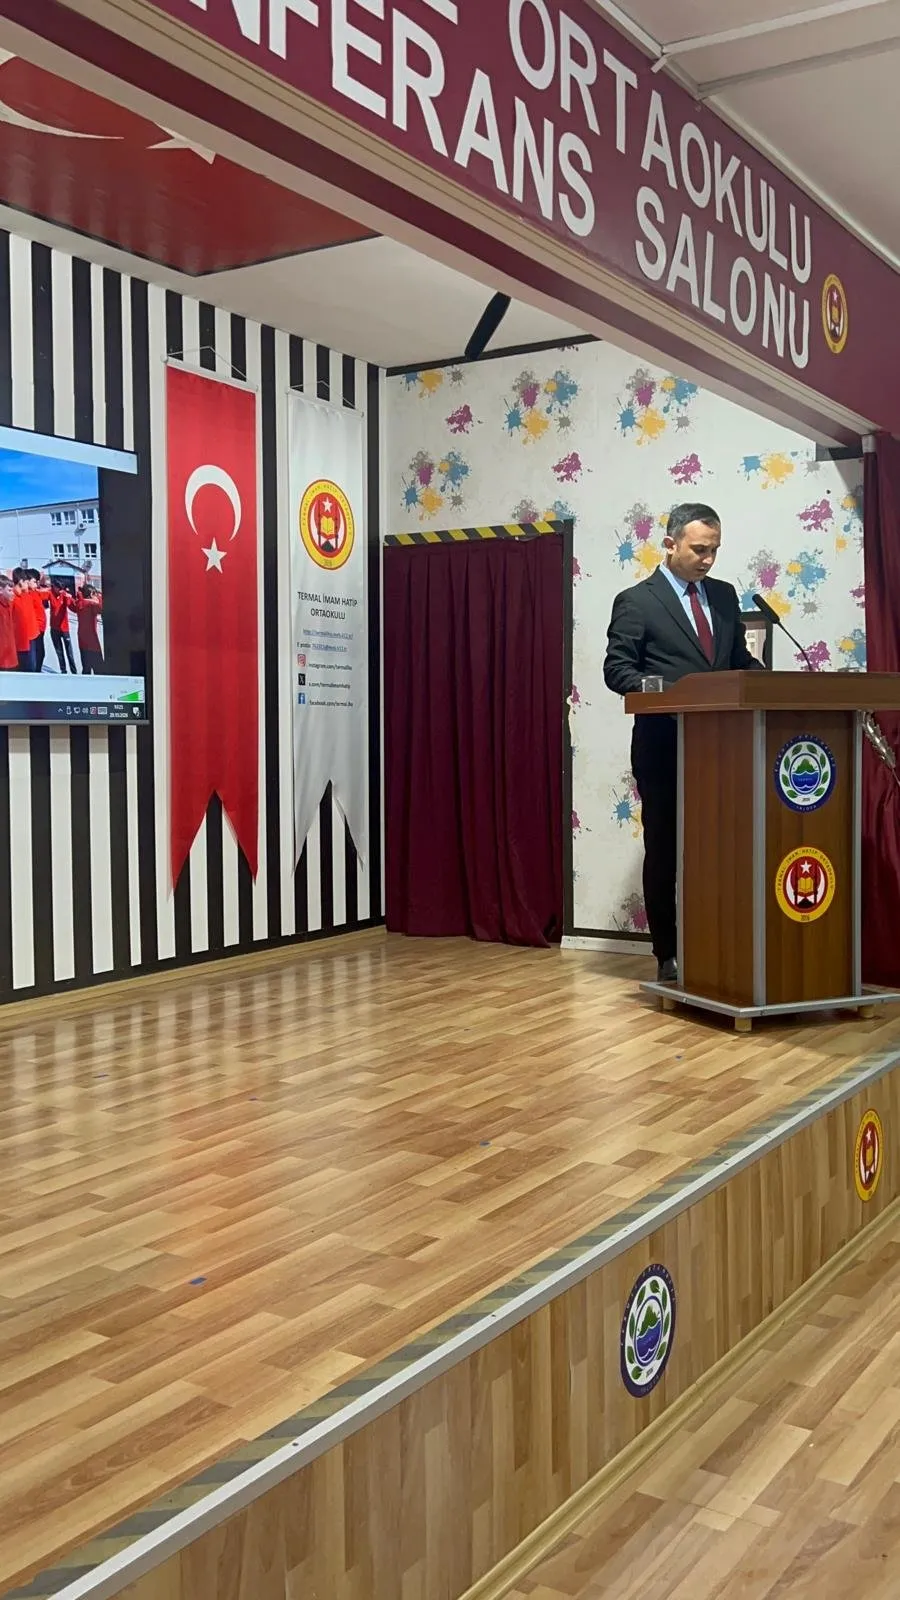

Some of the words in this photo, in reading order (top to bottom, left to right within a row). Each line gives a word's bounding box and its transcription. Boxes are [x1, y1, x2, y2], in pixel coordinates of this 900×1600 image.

[509, 0, 811, 284] ORTAOKULU
[635, 186, 809, 369] SALONU
[297, 591, 321, 603] TERMAL
[322, 593, 340, 605] İMAM
[341, 596, 358, 607] HATİP
[310, 608, 346, 620] ORTAOKULU
